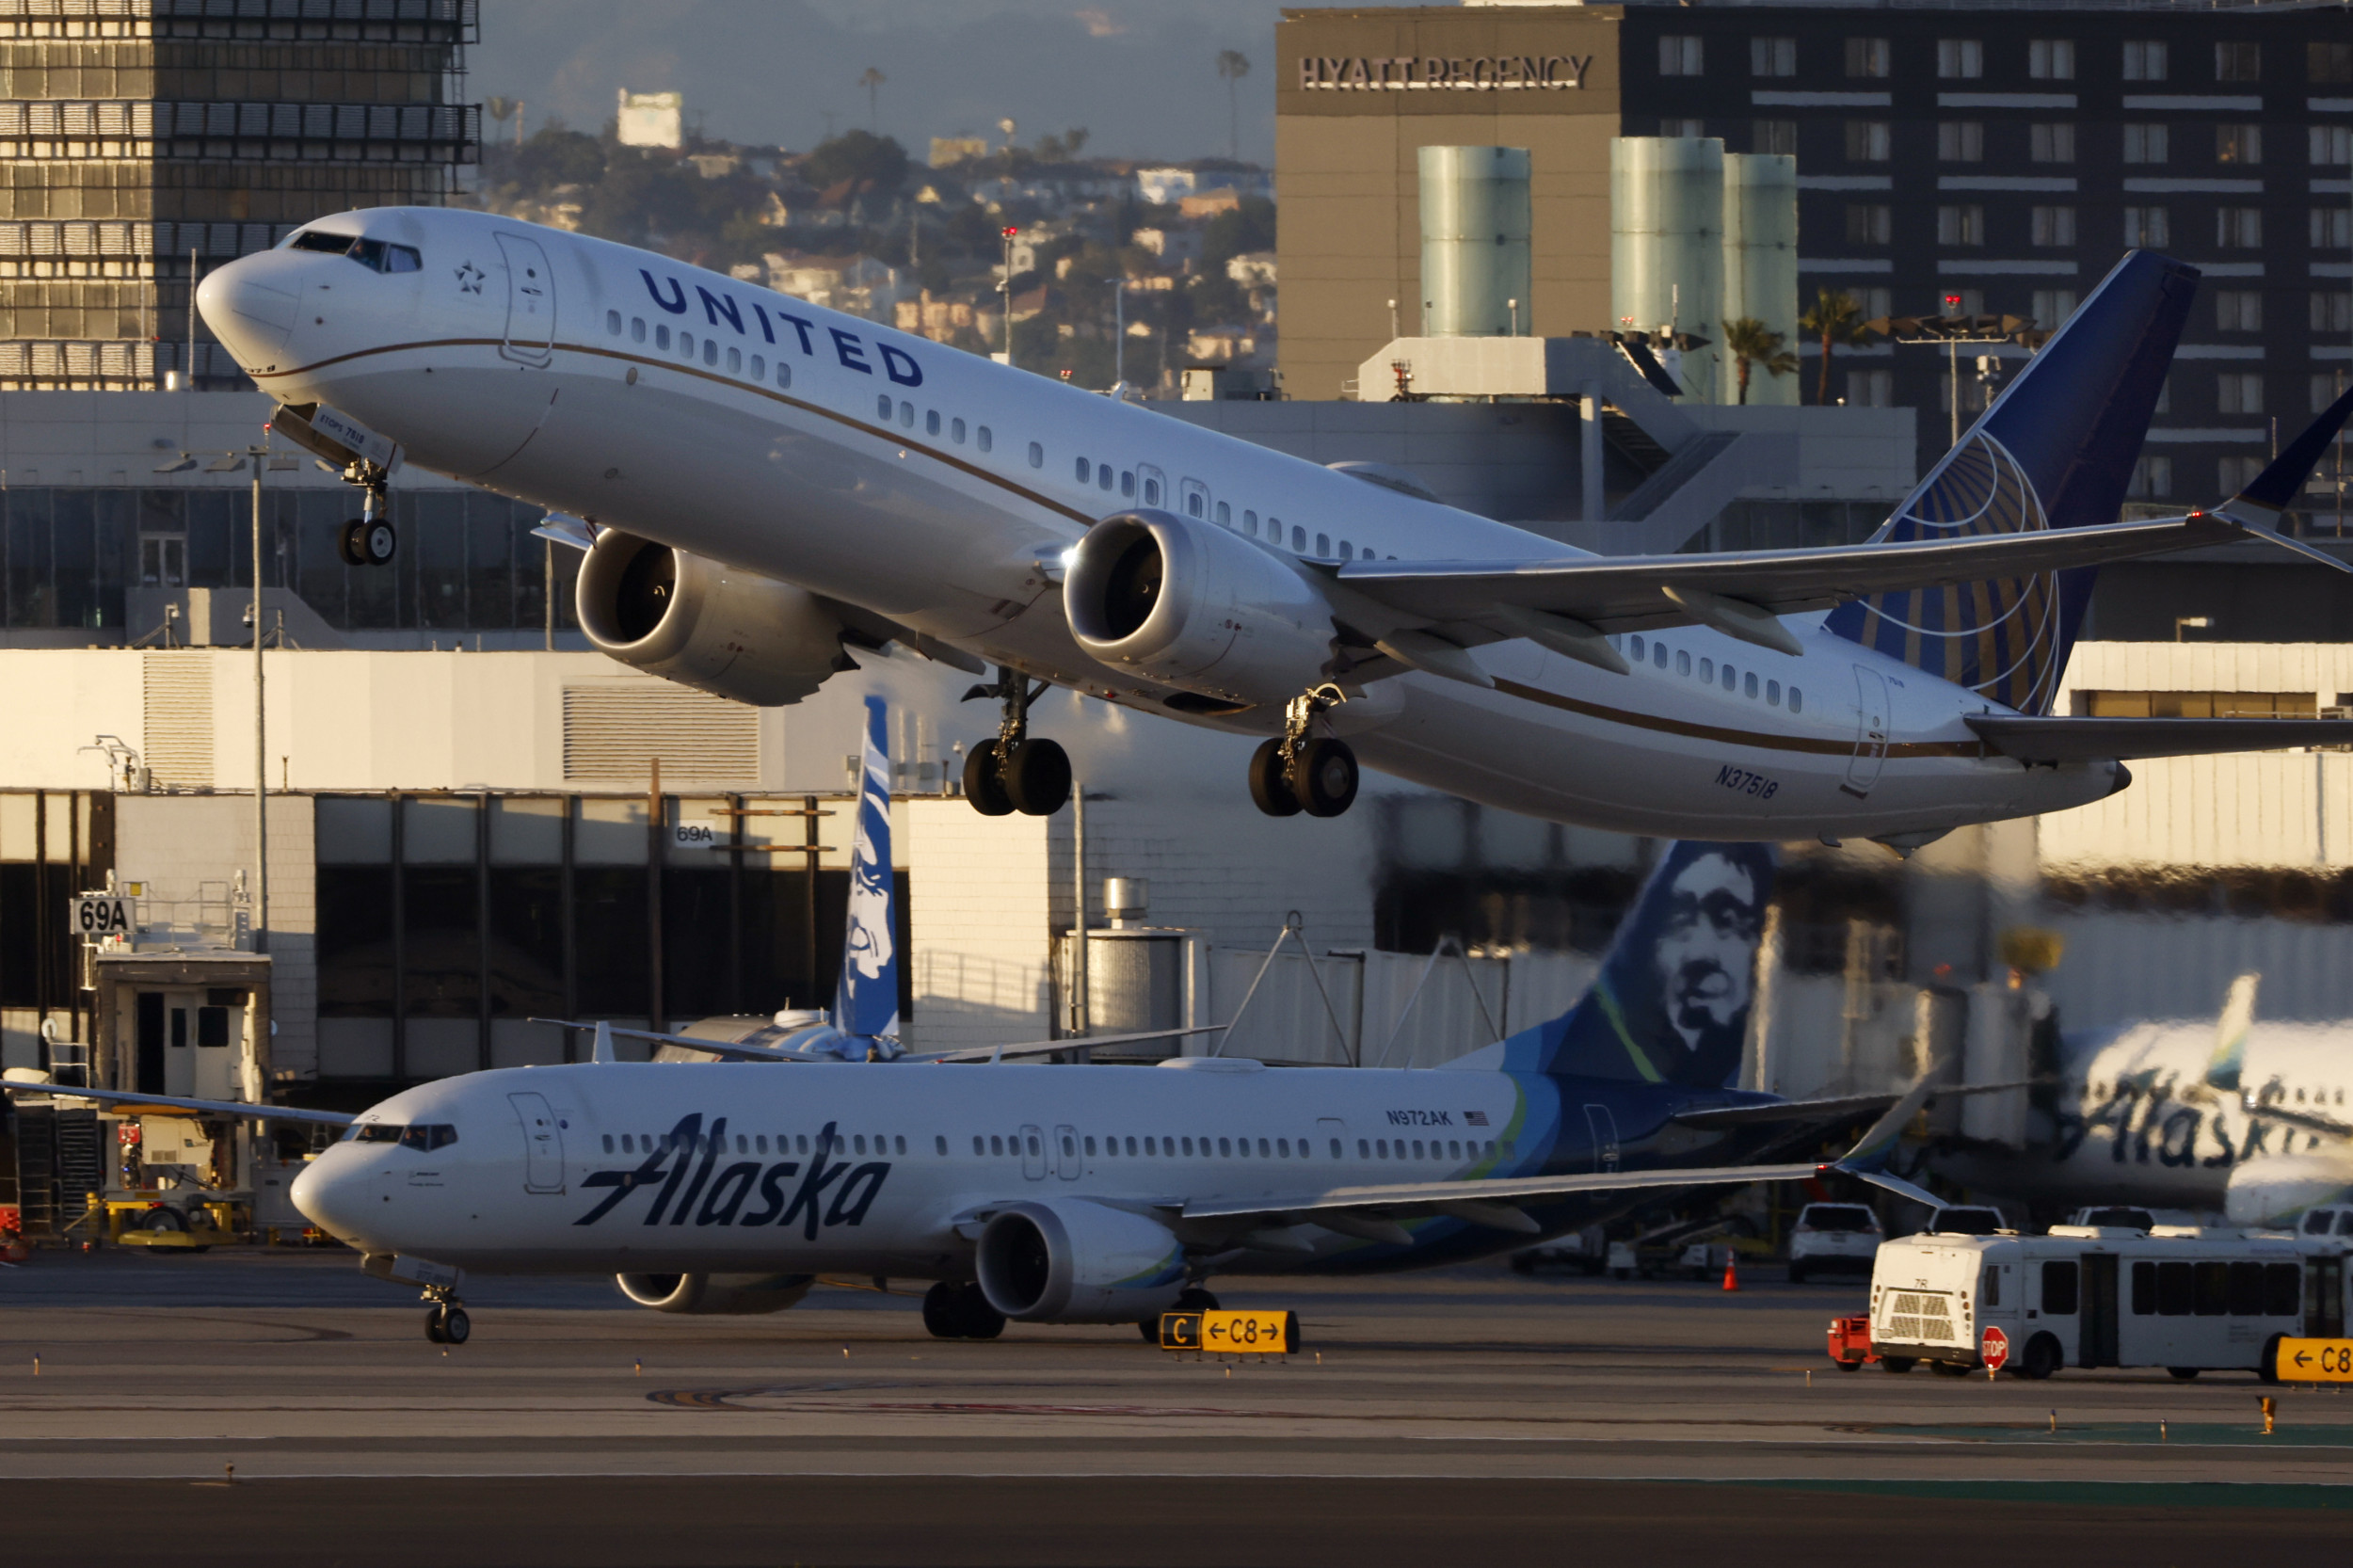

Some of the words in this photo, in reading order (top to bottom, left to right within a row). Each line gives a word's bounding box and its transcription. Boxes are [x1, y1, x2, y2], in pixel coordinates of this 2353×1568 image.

[1298, 56, 1416, 91] HYATT
[1425, 56, 1592, 91] REGENCY
[638, 268, 923, 387] UNITED
[320, 414, 344, 433] ETOPS
[345, 426, 365, 444] 7518
[1715, 764, 1779, 799] N37518
[676, 825, 712, 841] 69A
[80, 901, 128, 931] 69A
[1386, 1111, 1453, 1126] N972AK
[571, 1112, 892, 1241] Alaska
[1173, 1318, 1189, 1344] C
[1230, 1319, 1257, 1344] C8
[1982, 1340, 2007, 1356] STOP
[2321, 1347, 2352, 1373] C8
